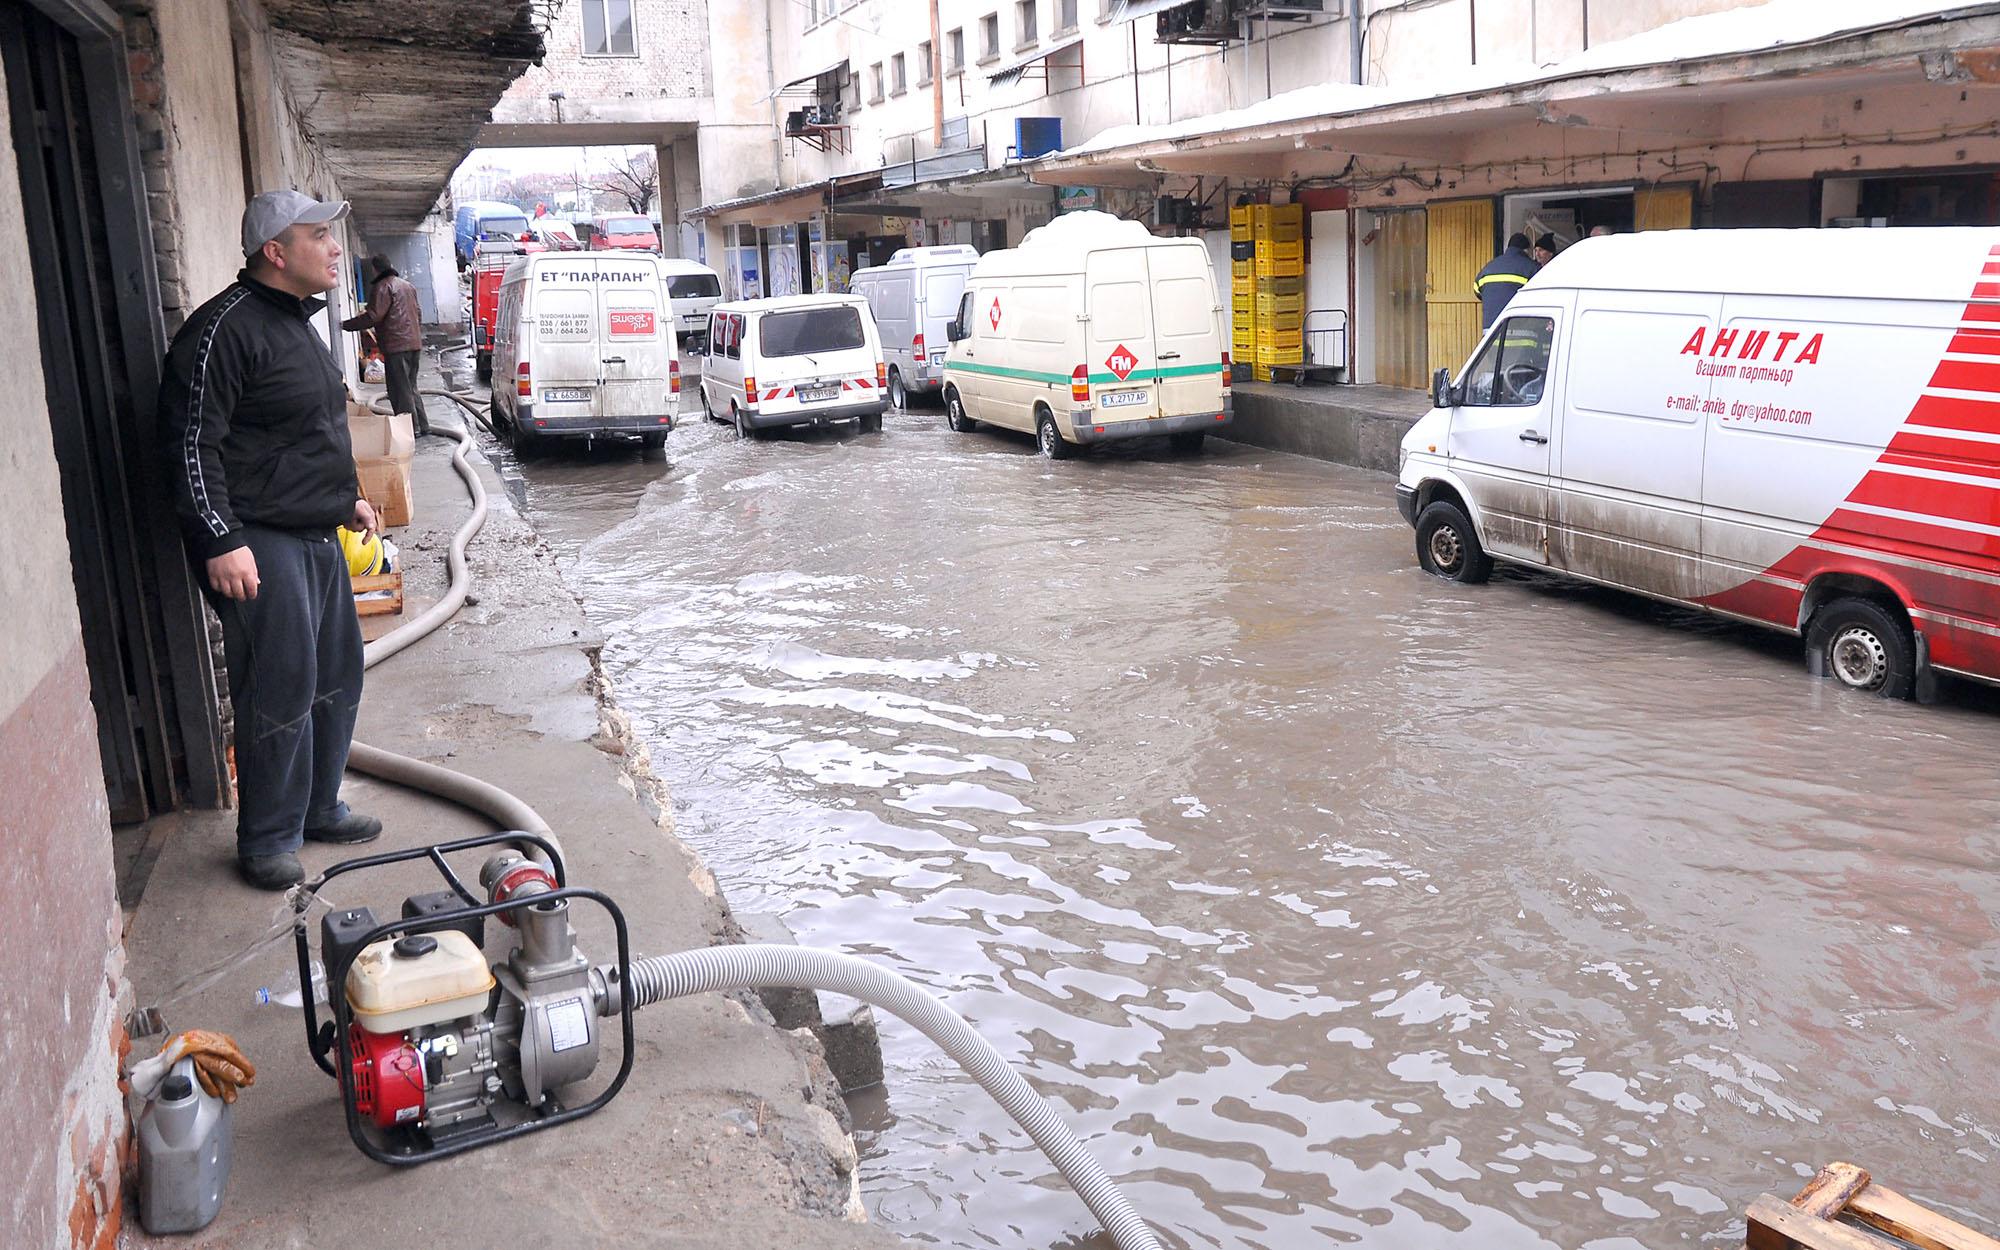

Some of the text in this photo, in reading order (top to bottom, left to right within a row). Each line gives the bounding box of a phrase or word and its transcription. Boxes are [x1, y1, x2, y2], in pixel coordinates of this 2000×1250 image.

[541, 272, 559, 282] ЕТ
[1680, 326, 1824, 364] АНИТА
[1110, 355, 1132, 371] FM
[1739, 366, 1793, 387] партньор
[1666, 394, 1812, 425] e-mail: anita_dgr@yahoo.com
